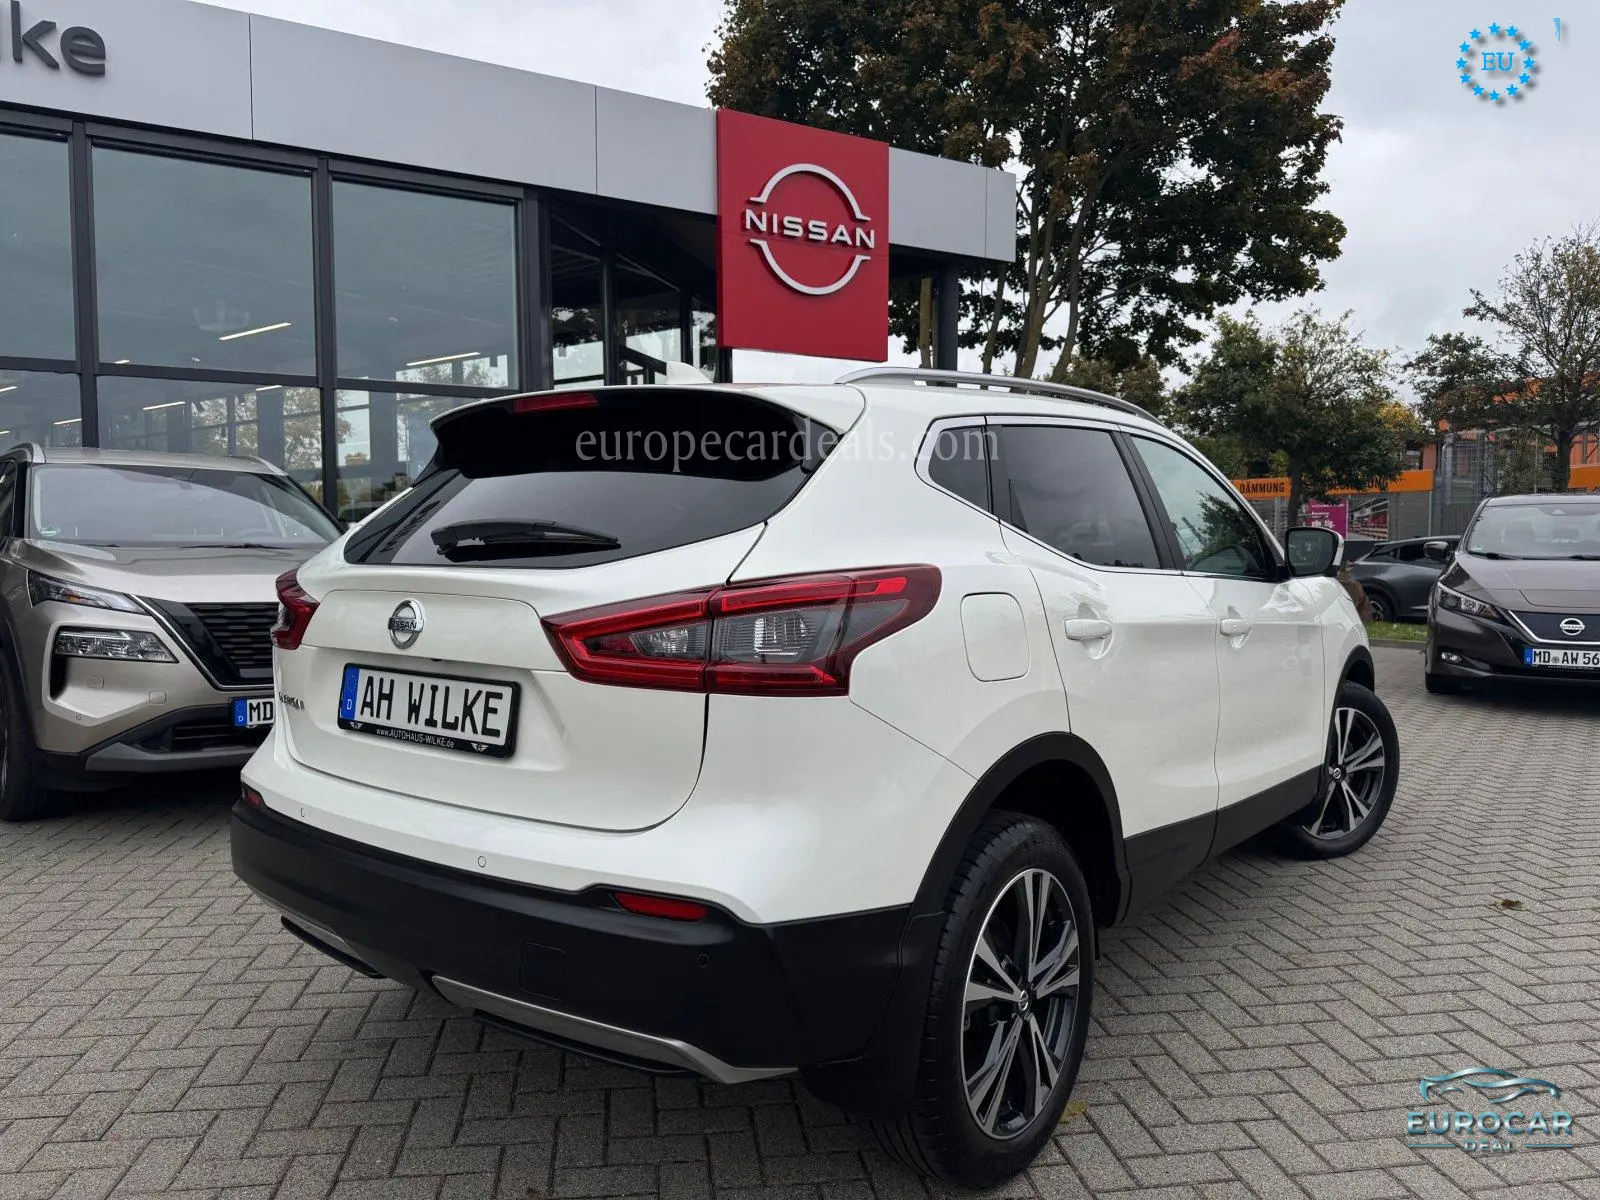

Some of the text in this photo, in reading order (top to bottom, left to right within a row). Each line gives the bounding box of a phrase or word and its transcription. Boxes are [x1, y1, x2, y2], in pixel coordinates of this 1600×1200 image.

[745, 209, 875, 248] NISSAN
[1240, 481, 1285, 494] DÄMMUNG
[1533, 651, 1551, 663] MD
[1562, 652, 1579, 664] AW
[1583, 653, 1600, 665] 56
[249, 701, 273, 721] MD
[360, 676, 394, 720] AH
[408, 682, 503, 737] WILKE
[376, 728, 454, 748] www.AUTOHAUS-WILKE.de
